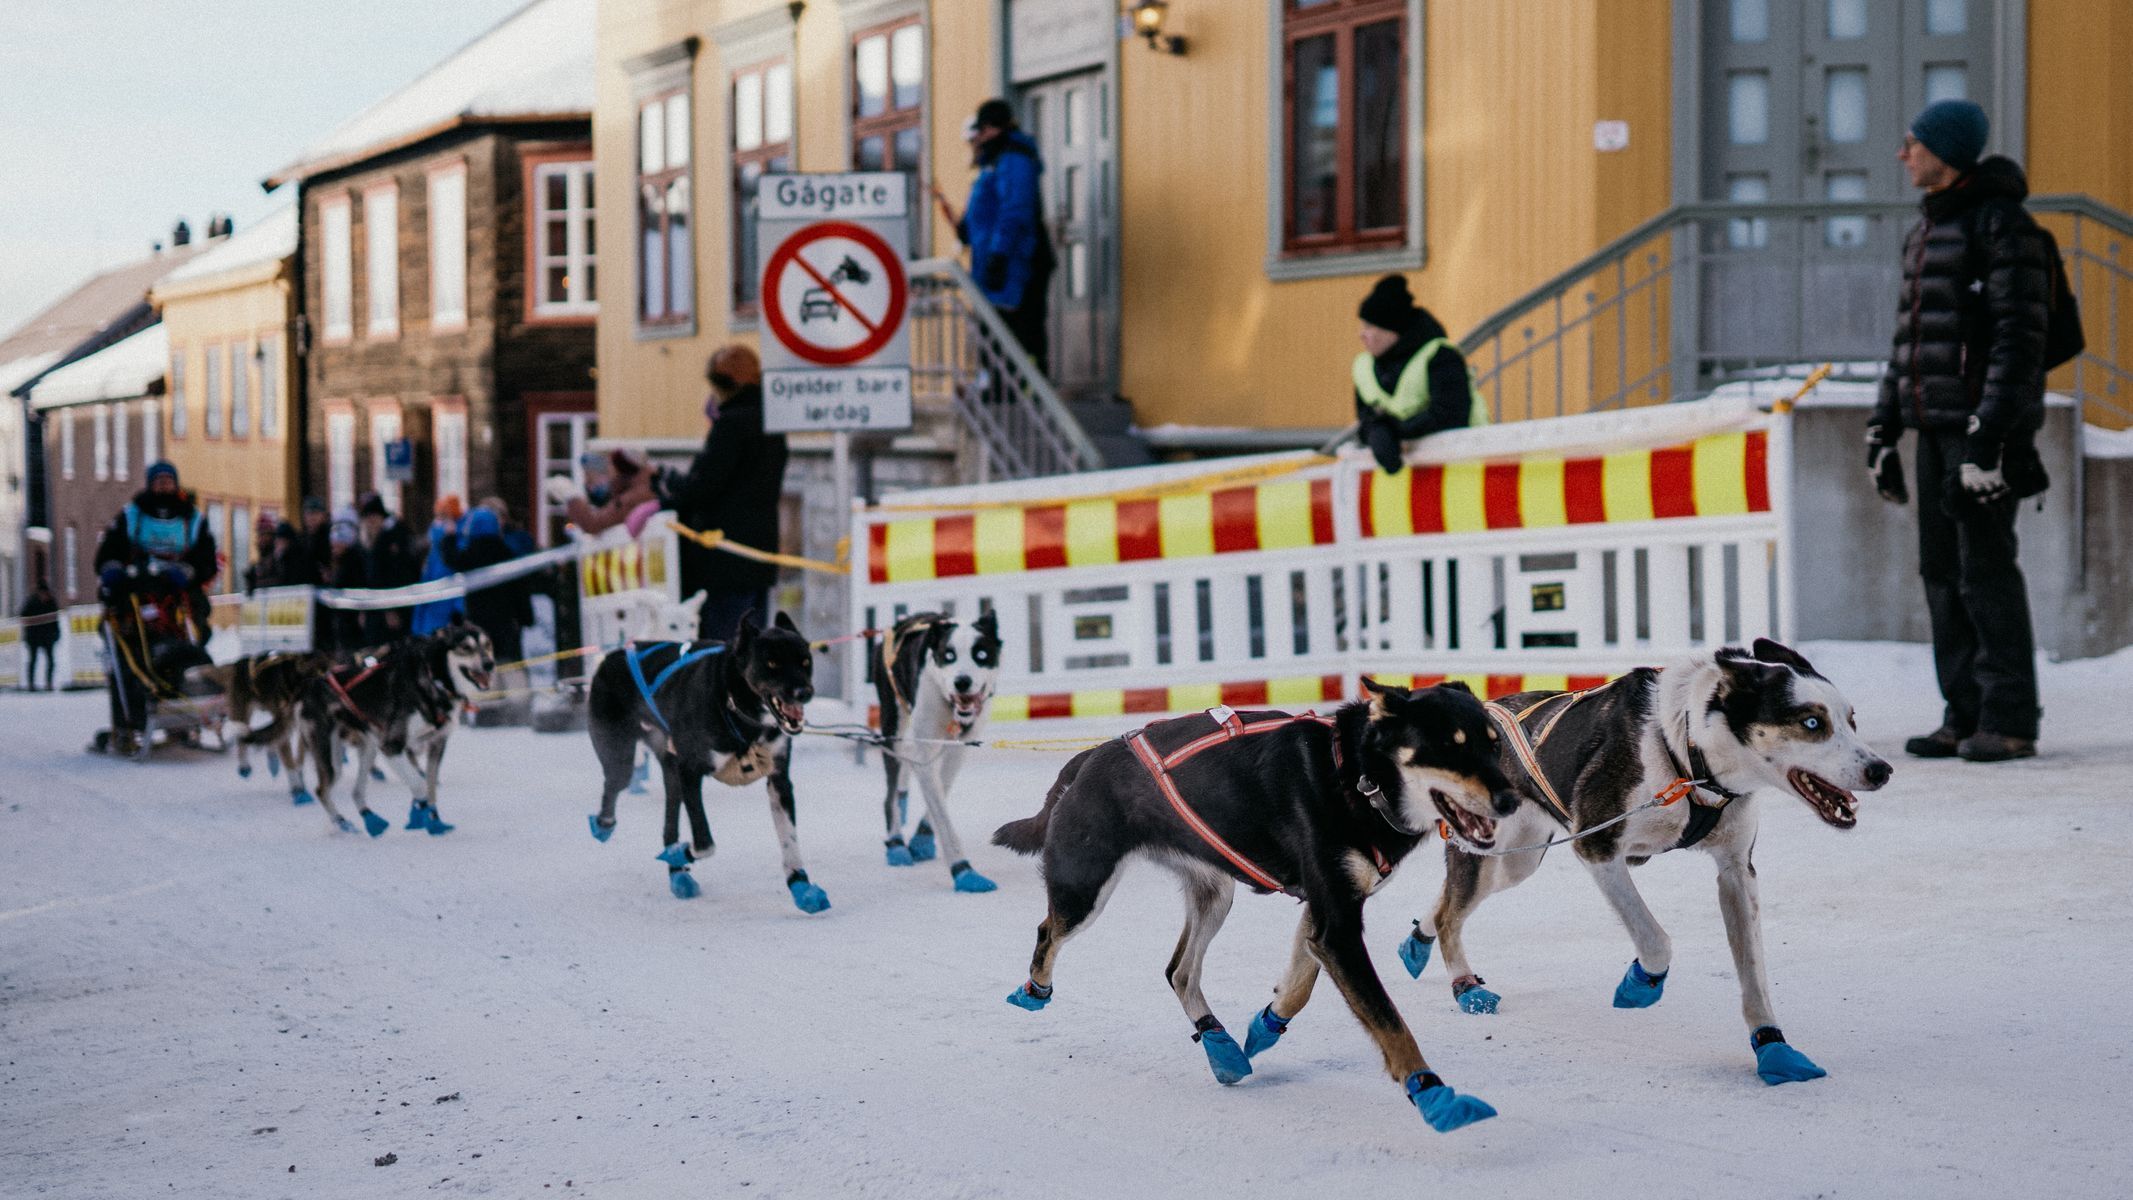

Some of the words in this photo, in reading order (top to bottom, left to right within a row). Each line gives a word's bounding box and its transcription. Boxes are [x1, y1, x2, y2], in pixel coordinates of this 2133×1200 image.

[777, 179, 887, 211] Gågate
[771, 377, 843, 399] Gjelder
[857, 377, 902, 394] bare
[806, 404, 870, 423] lørdag
